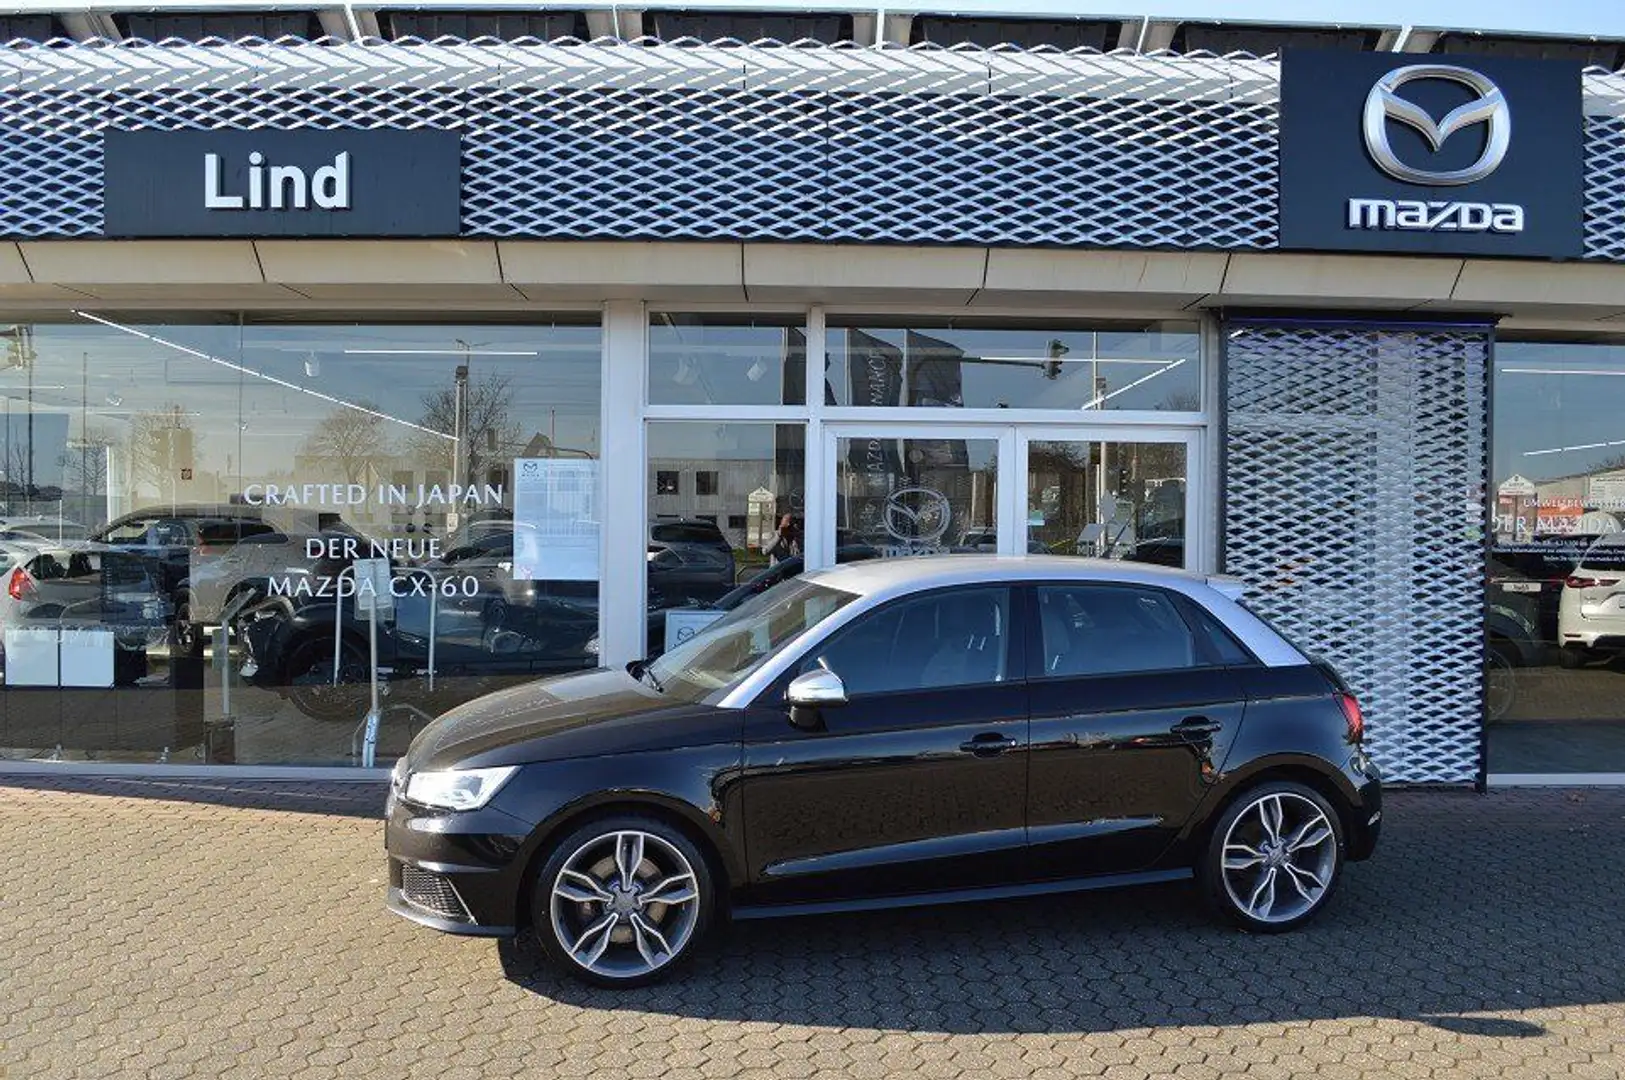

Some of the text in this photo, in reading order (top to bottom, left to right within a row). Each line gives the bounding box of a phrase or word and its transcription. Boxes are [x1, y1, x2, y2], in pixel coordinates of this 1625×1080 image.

[205, 150, 349, 209] Lind
[1349, 198, 1525, 233] mazda
[244, 484, 503, 508] CRAFTED IN JAPAN
[306, 538, 442, 559] DER NEUE
[267, 575, 479, 598] MAZDA CX-60
